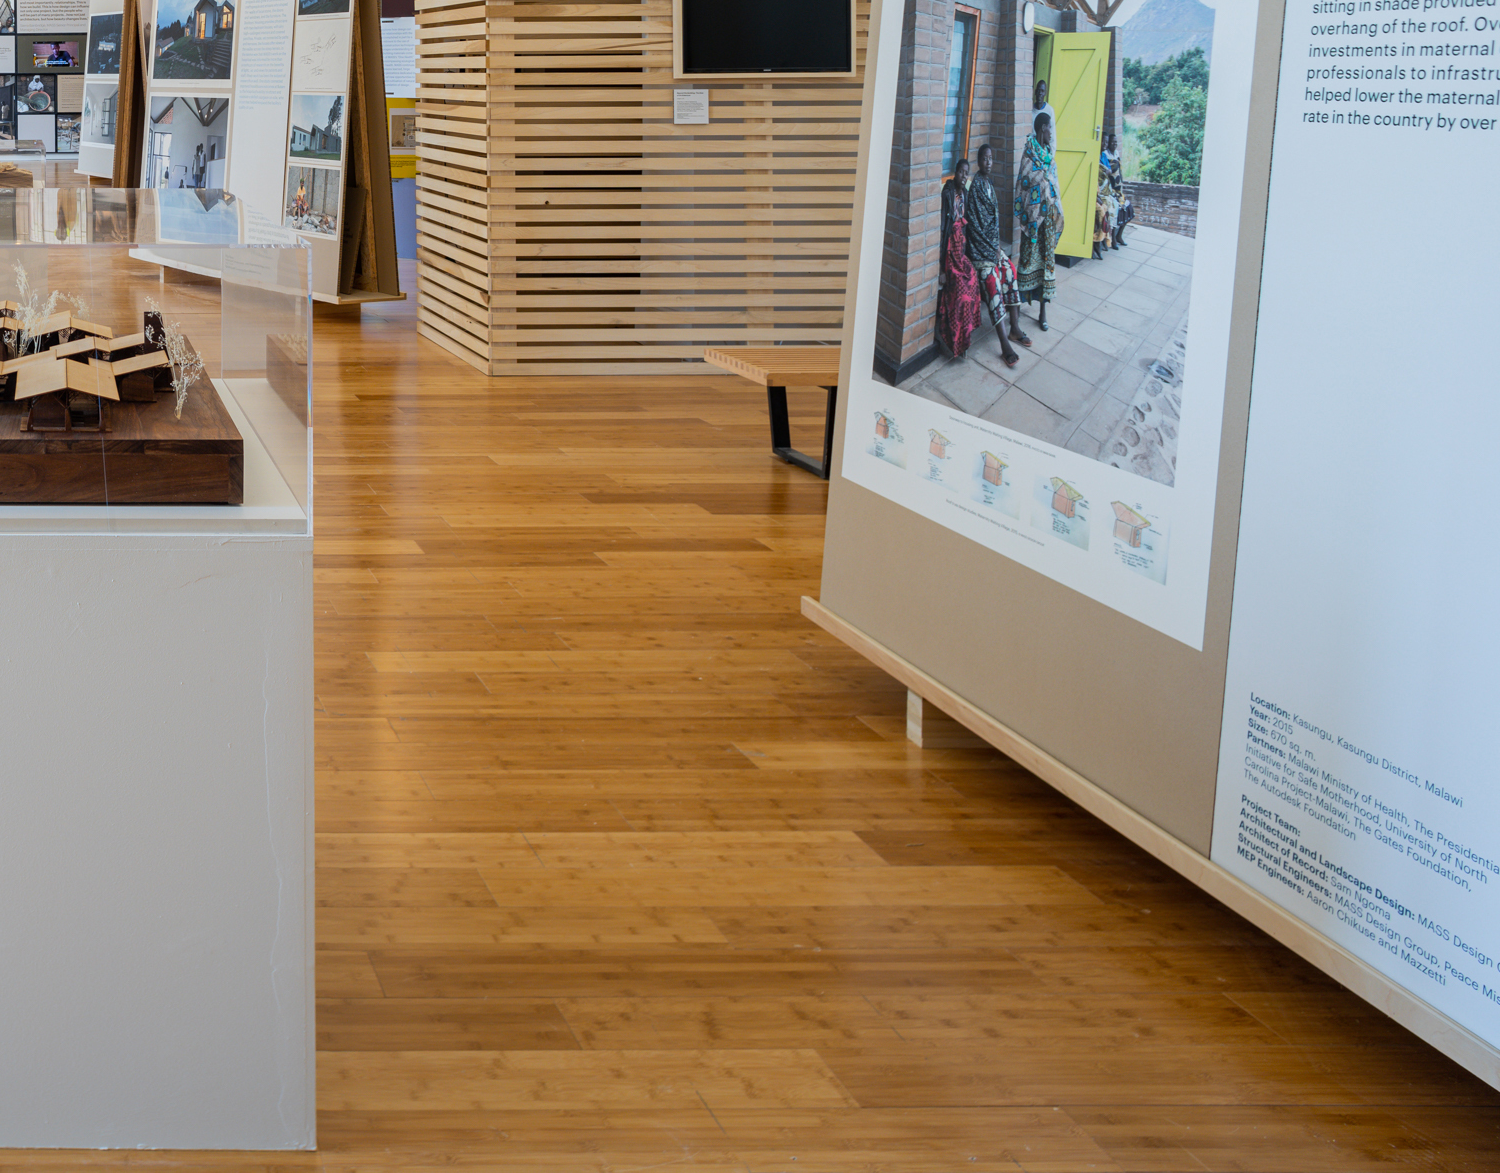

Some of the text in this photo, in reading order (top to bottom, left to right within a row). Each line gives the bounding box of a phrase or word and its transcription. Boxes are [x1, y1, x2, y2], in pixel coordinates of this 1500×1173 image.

[1308, 40, 1495, 58] investments in maternal
[1302, 109, 1498, 132] rate in the country by over
[1247, 717, 1269, 737] Size:
[1270, 729, 1288, 746] 670
[1249, 703, 1294, 736] Year: 2015
[1250, 691, 1291, 721] Location:
[1337, 735, 1379, 766] Kasungu
[1424, 779, 1463, 808] Malawi
[1241, 793, 1301, 837] Project Team:
[1238, 820, 1280, 852] Architect
[1291, 851, 1329, 883] Record:
[1330, 875, 1352, 897] Sam
[1354, 890, 1391, 921] Ngoma
[1236, 844, 1446, 986] MEP Engineers: Aaron Chikuse and Mazzetti
